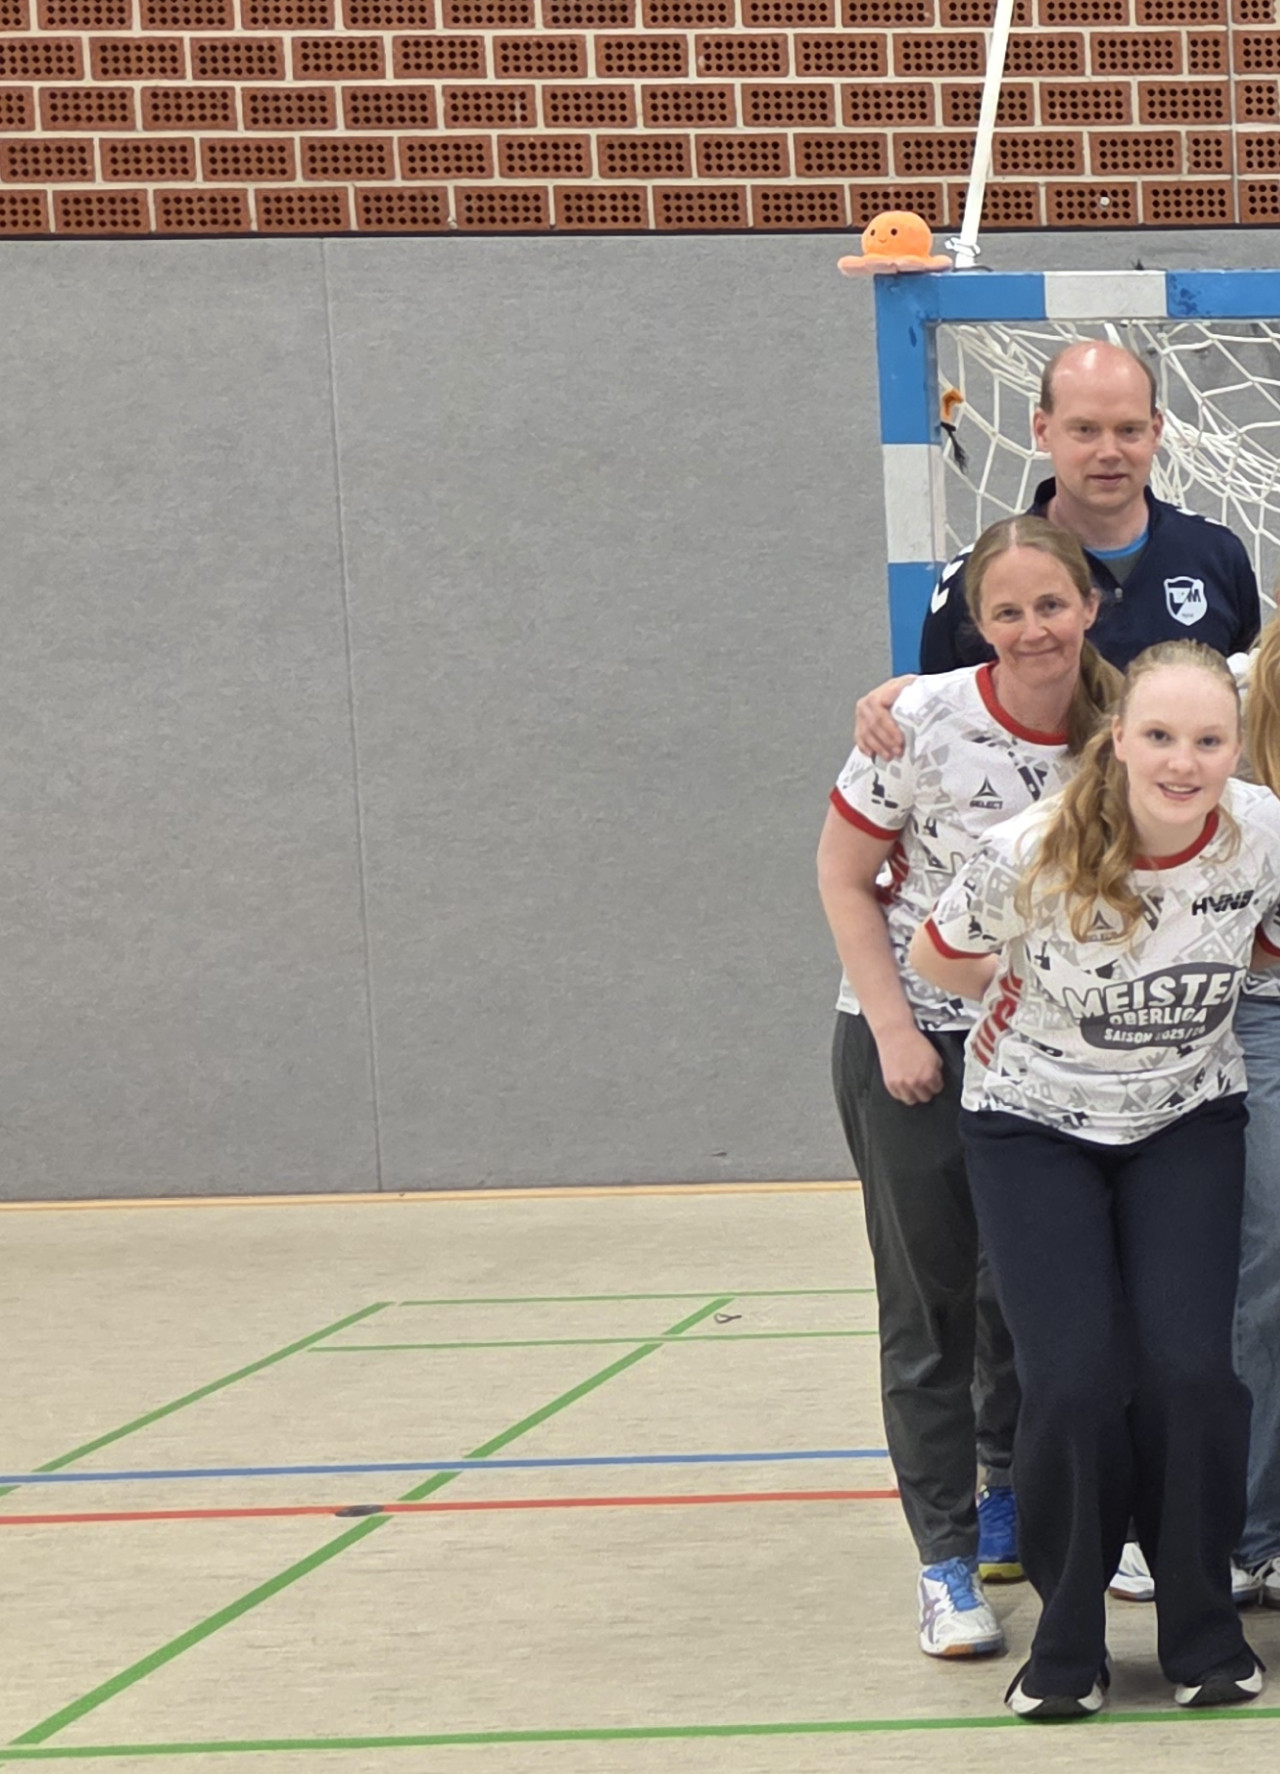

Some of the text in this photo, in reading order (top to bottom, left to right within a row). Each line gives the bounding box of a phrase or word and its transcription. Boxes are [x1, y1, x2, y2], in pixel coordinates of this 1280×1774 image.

[969, 800, 1003, 810] SELECT
[1109, 1007, 1208, 1027] OBERLIGA
[1103, 1027, 1153, 1045] SAISON
